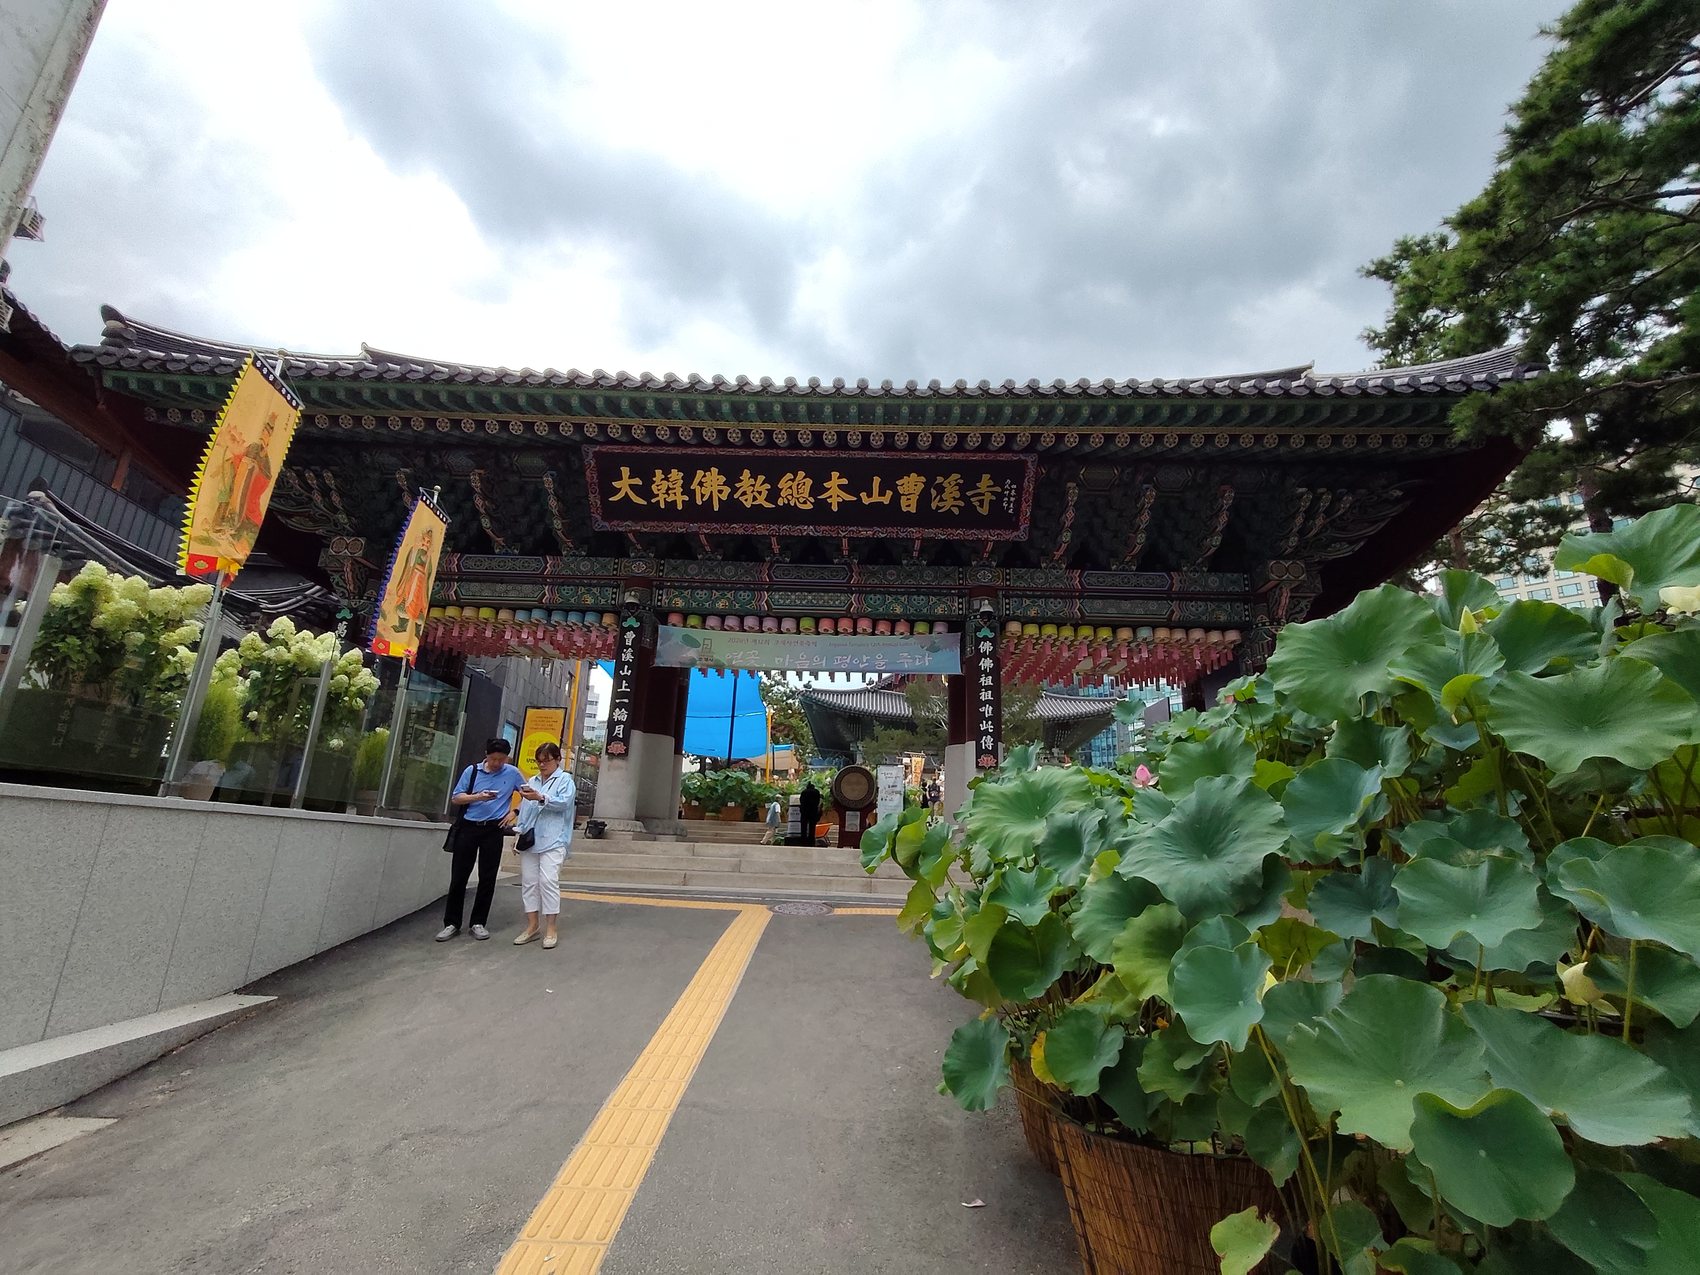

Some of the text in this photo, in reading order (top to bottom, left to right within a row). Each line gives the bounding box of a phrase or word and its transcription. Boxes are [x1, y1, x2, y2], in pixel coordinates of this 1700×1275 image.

[774, 652, 826, 669] 마음의
[832, 653, 889, 670] 평안을
[896, 651, 933, 669] 주다
